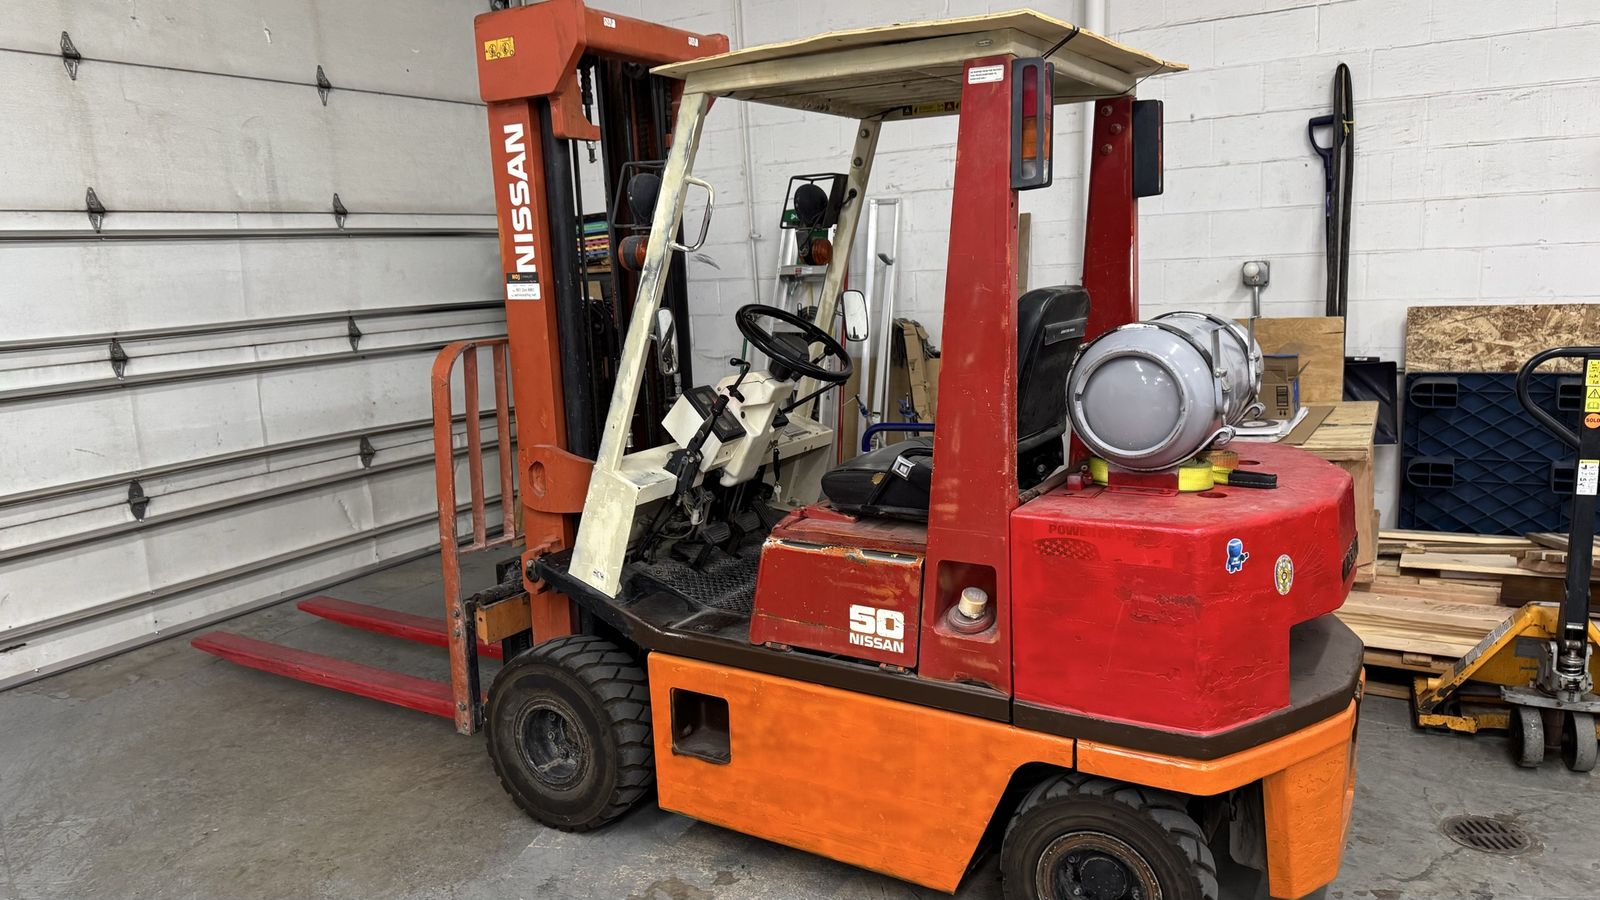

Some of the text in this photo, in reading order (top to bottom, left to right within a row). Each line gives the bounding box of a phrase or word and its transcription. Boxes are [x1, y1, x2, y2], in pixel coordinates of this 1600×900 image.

[503, 123, 537, 273] NISSAN
[849, 604, 905, 640] 50
[849, 632, 904, 654] NISSAN
